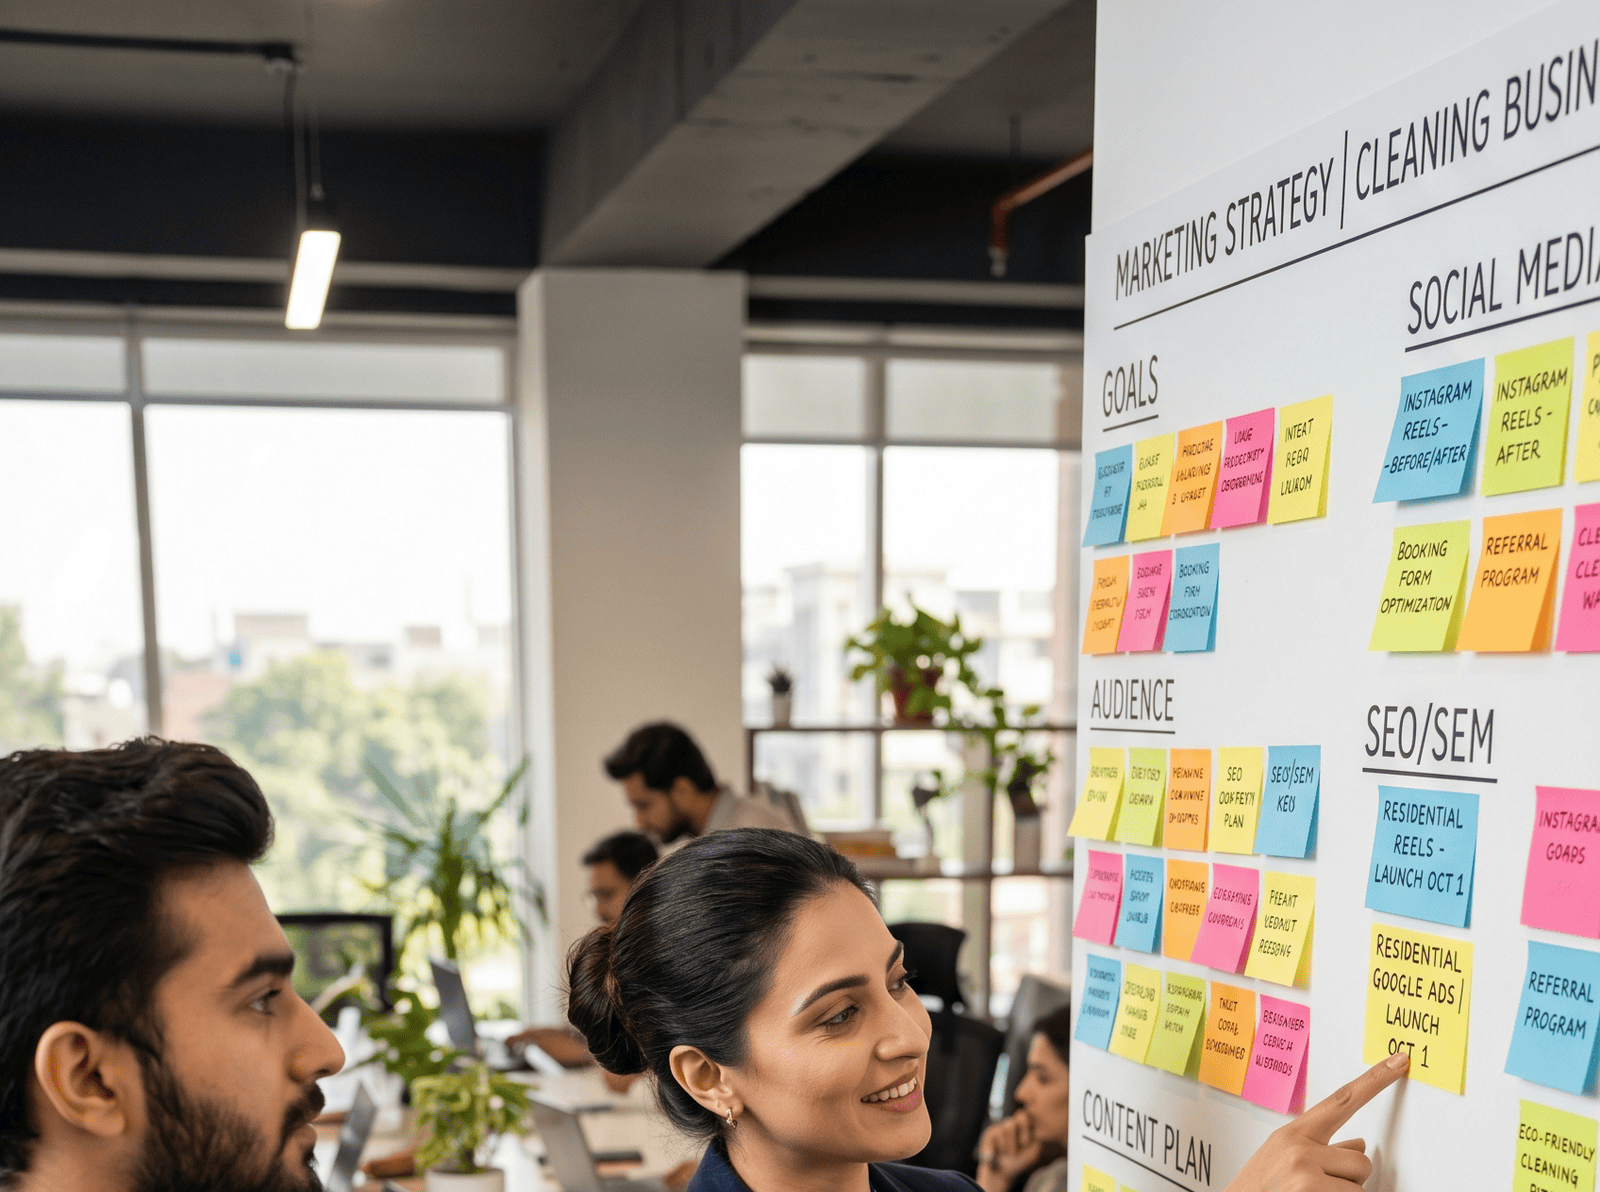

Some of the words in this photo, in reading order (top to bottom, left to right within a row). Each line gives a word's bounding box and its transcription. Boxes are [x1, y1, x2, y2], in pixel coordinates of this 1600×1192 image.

[1116, 211, 1217, 301] MARKETING
[1225, 157, 1334, 256] STRATEGY
[1355, 89, 1490, 201] CLEANING
[1503, 38, 1600, 142] BUSIN
[1407, 257, 1503, 335] SOCIAL
[1103, 355, 1158, 417] GOALS
[1403, 380, 1473, 413] INSTAGRAM
[1496, 367, 1568, 402] INSTAGRAM
[1501, 406, 1542, 432] REELS
[1495, 440, 1541, 466] AFTER
[1397, 540, 1448, 561] BOOKING
[1485, 533, 1548, 556] REFERRAL
[1398, 569, 1432, 587] FORM
[1480, 567, 1540, 588] PROGRAM
[1380, 595, 1453, 614] OPTIMIZATION
[1091, 679, 1175, 721] AUDIENCE
[1365, 703, 1494, 765] SEO/SEM
[1226, 766, 1243, 782] SEO
[1224, 813, 1244, 828] PLAN
[1383, 800, 1463, 829] RESIDENTIAL
[1393, 834, 1434, 858] REELS
[1374, 863, 1424, 889] LAUNCH
[1427, 871, 1453, 893] OCT
[1456, 874, 1464, 896] 1
[1376, 933, 1462, 973] RESIDENTIAL
[1373, 968, 1423, 998] GOOGLE
[1427, 980, 1455, 1005] ADS
[1528, 971, 1594, 1003] REFERRAL
[1386, 1003, 1440, 1036] LAUNCH
[1524, 1006, 1586, 1040] PROGRAM
[1420, 1045, 1429, 1068] 1
[1082, 1089, 1158, 1159] CONTENT
[1164, 1124, 1211, 1187] PLAN
[1519, 1123, 1596, 1163] ECO-FRIENDLY
[1520, 1153, 1579, 1189] CLEANING
